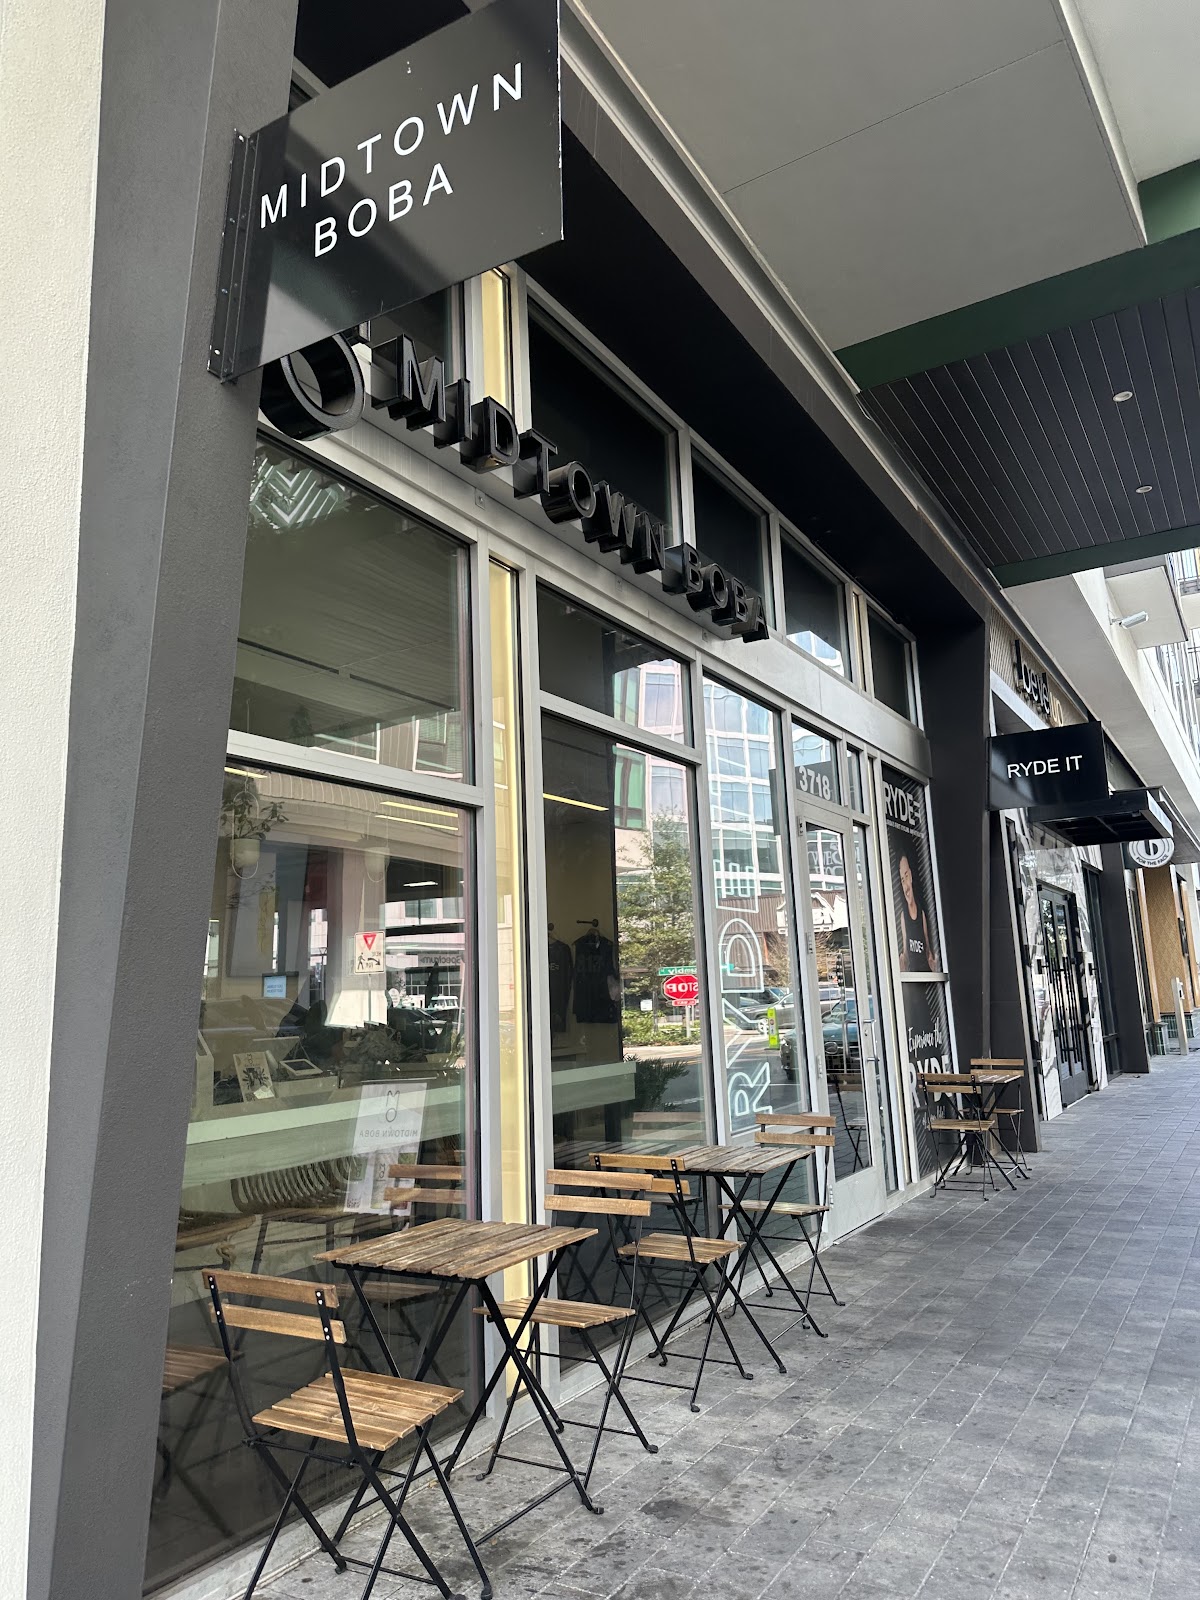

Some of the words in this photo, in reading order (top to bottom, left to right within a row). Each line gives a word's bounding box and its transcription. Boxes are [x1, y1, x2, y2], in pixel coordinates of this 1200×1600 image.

[260, 62, 522, 229] MIDTOWN
[314, 162, 453, 258] BOBA
[372, 333, 666, 576] MIDTOWN
[662, 541, 770, 643] BOBA
[798, 765, 831, 801] 3718
[1007, 758, 1060, 779] RYDE
[1065, 755, 1083, 772] IT
